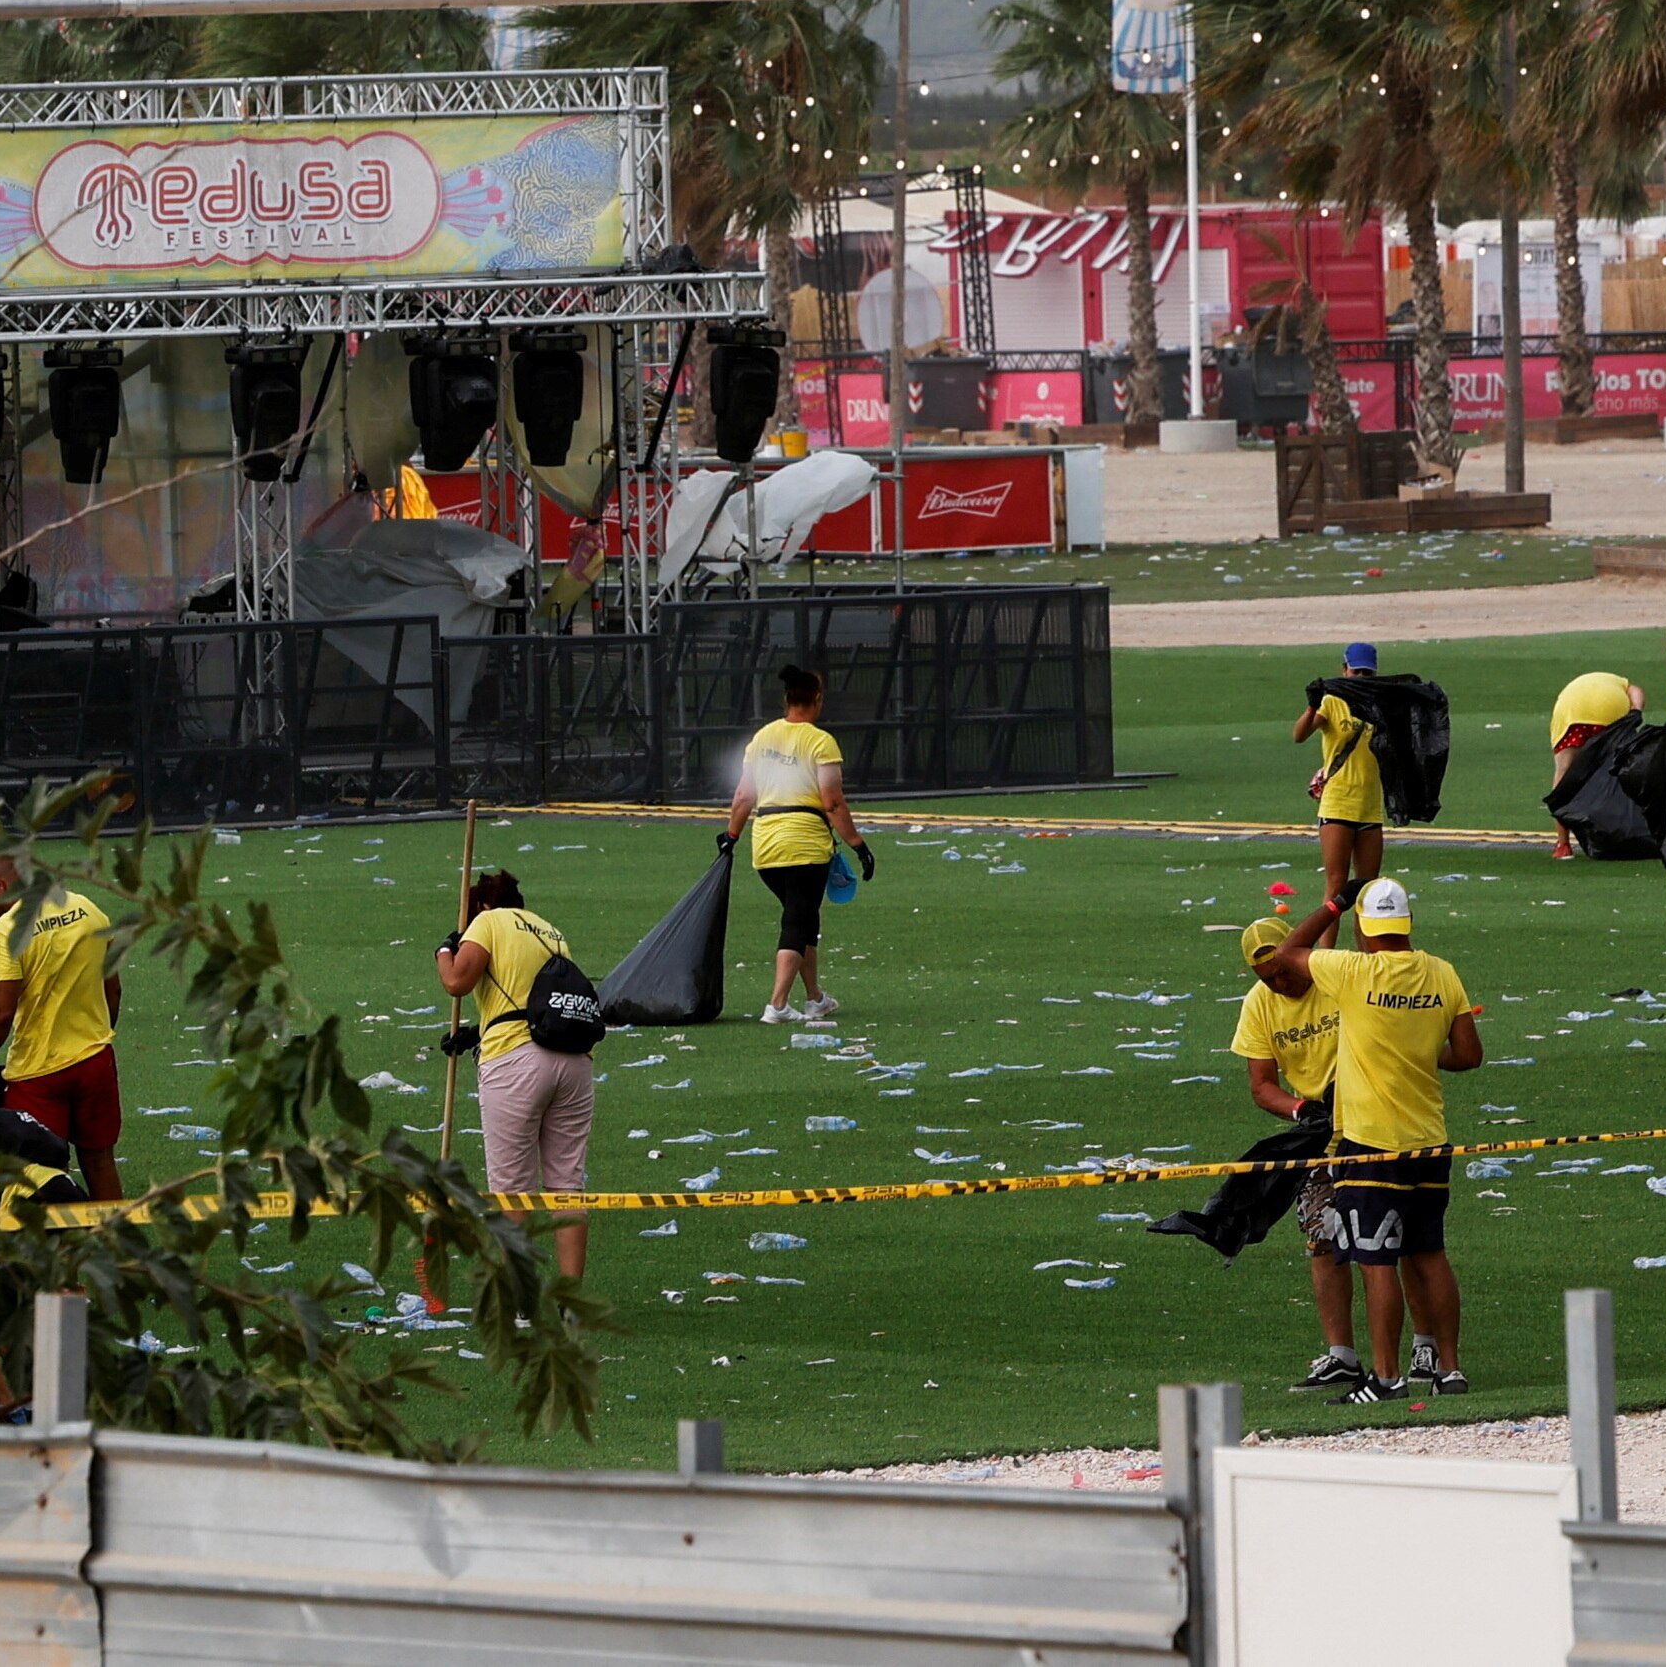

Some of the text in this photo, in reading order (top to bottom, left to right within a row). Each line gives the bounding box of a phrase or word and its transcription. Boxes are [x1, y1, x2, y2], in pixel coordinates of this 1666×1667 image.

[167, 227, 354, 246] FESTIVAL
[926, 491, 1003, 510] Budweiser
[1367, 991, 1444, 1010] LIMPIEZA
